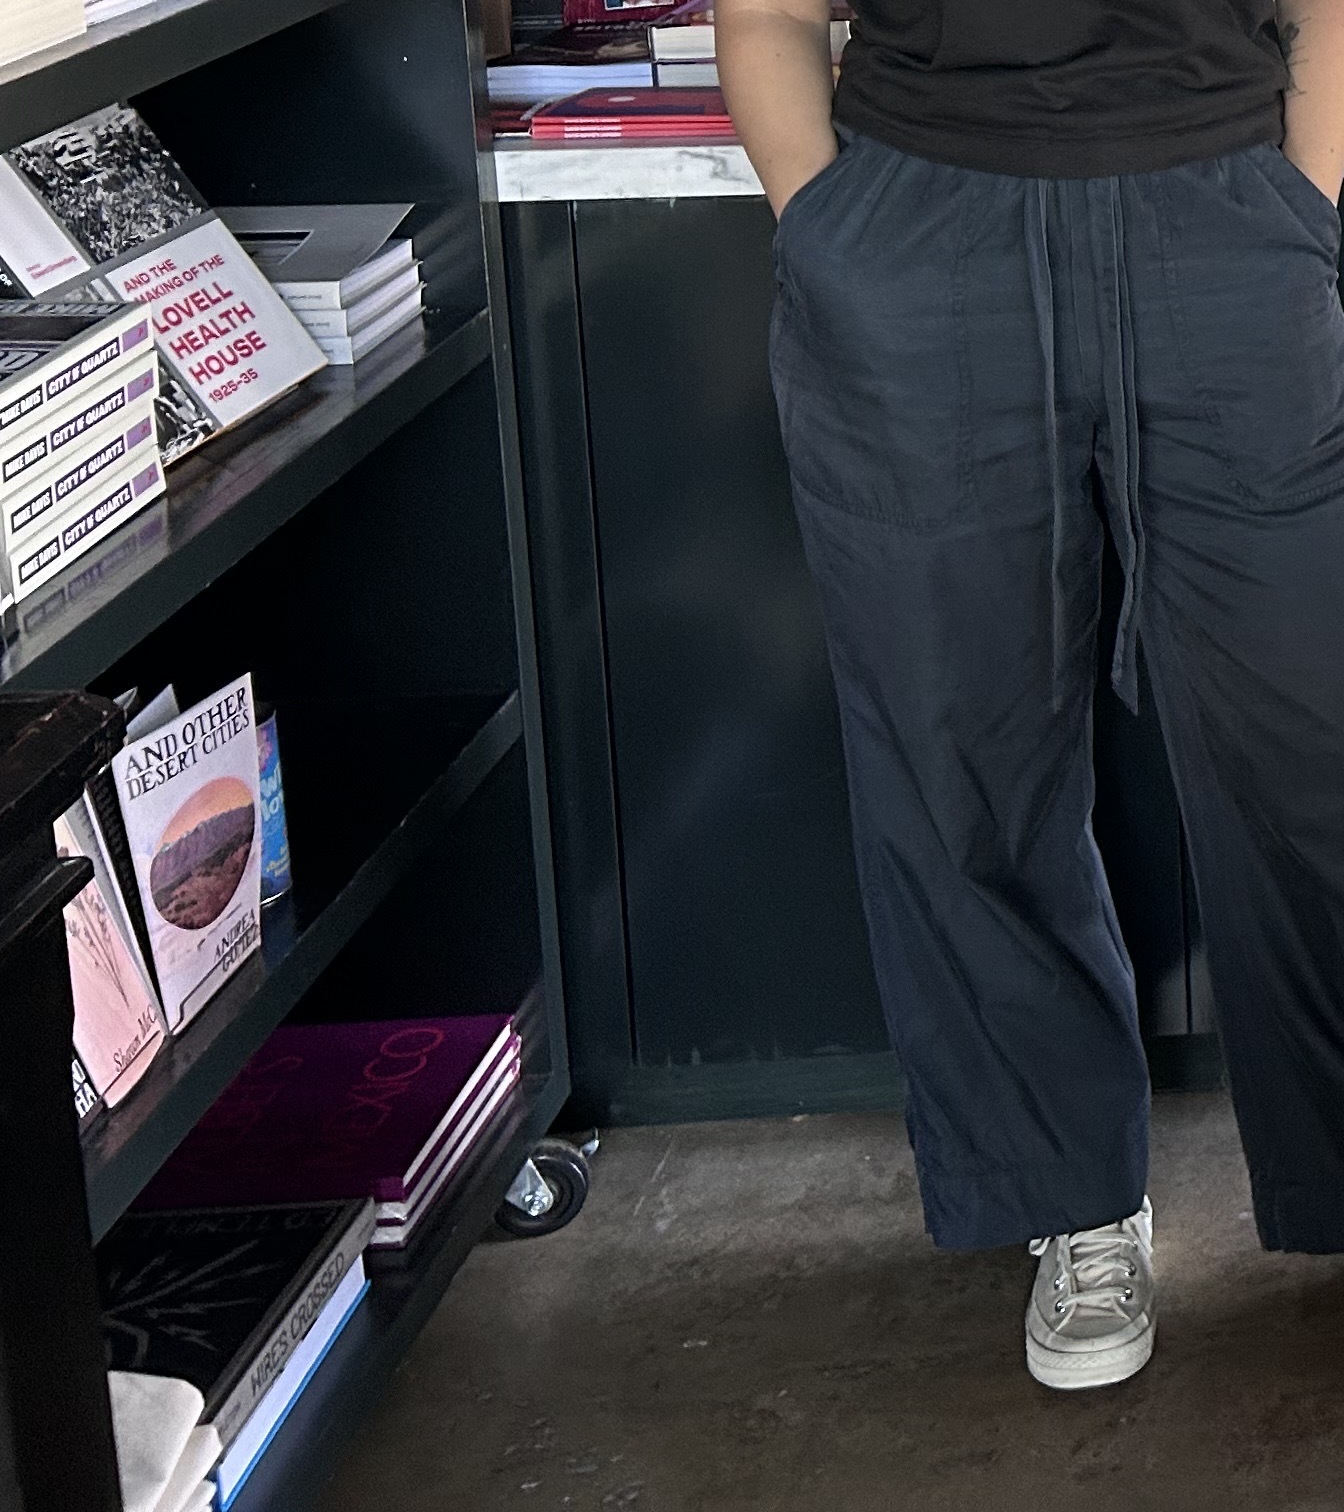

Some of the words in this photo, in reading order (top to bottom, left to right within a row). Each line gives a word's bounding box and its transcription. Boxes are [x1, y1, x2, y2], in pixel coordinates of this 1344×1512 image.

[151, 281, 234, 334] LOVELL
[168, 301, 256, 359] HEALTH
[188, 330, 267, 385] HOUSE
[126, 736, 178, 780] AND
[181, 688, 247, 744] OTHER
[127, 749, 199, 800] DESERT
[201, 708, 250, 756] CITIES
